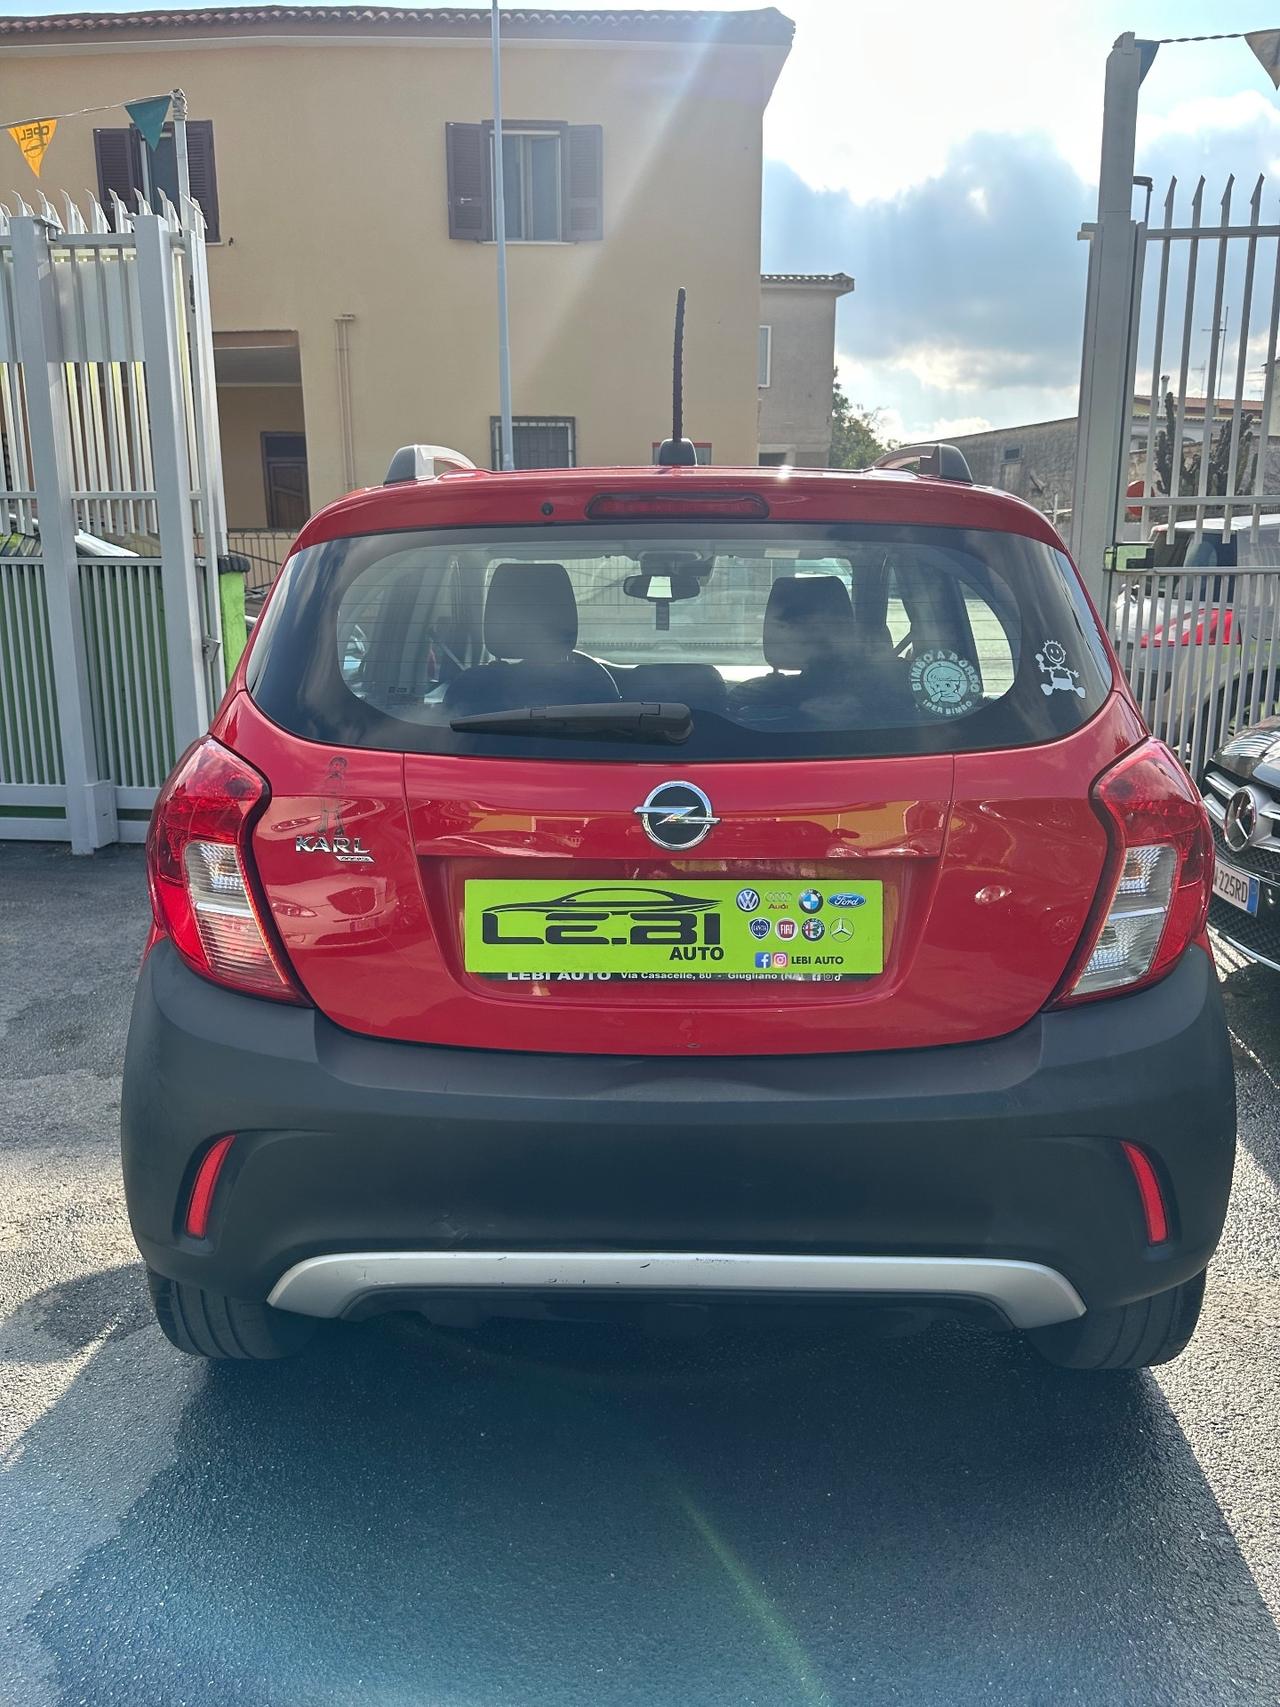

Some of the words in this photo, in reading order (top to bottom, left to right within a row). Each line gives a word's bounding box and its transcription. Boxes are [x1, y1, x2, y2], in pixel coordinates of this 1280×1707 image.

[937, 650, 946, 661] A
[295, 835, 371, 853] KARL
[834, 894, 860, 906] Ford
[780, 924, 794, 935] FIAT
[669, 946, 725, 961] AUTO
[791, 956, 811, 965] LEBI
[814, 956, 844, 965] AUTO
[507, 972, 550, 981] LEBI
[557, 972, 612, 981] AUTO
